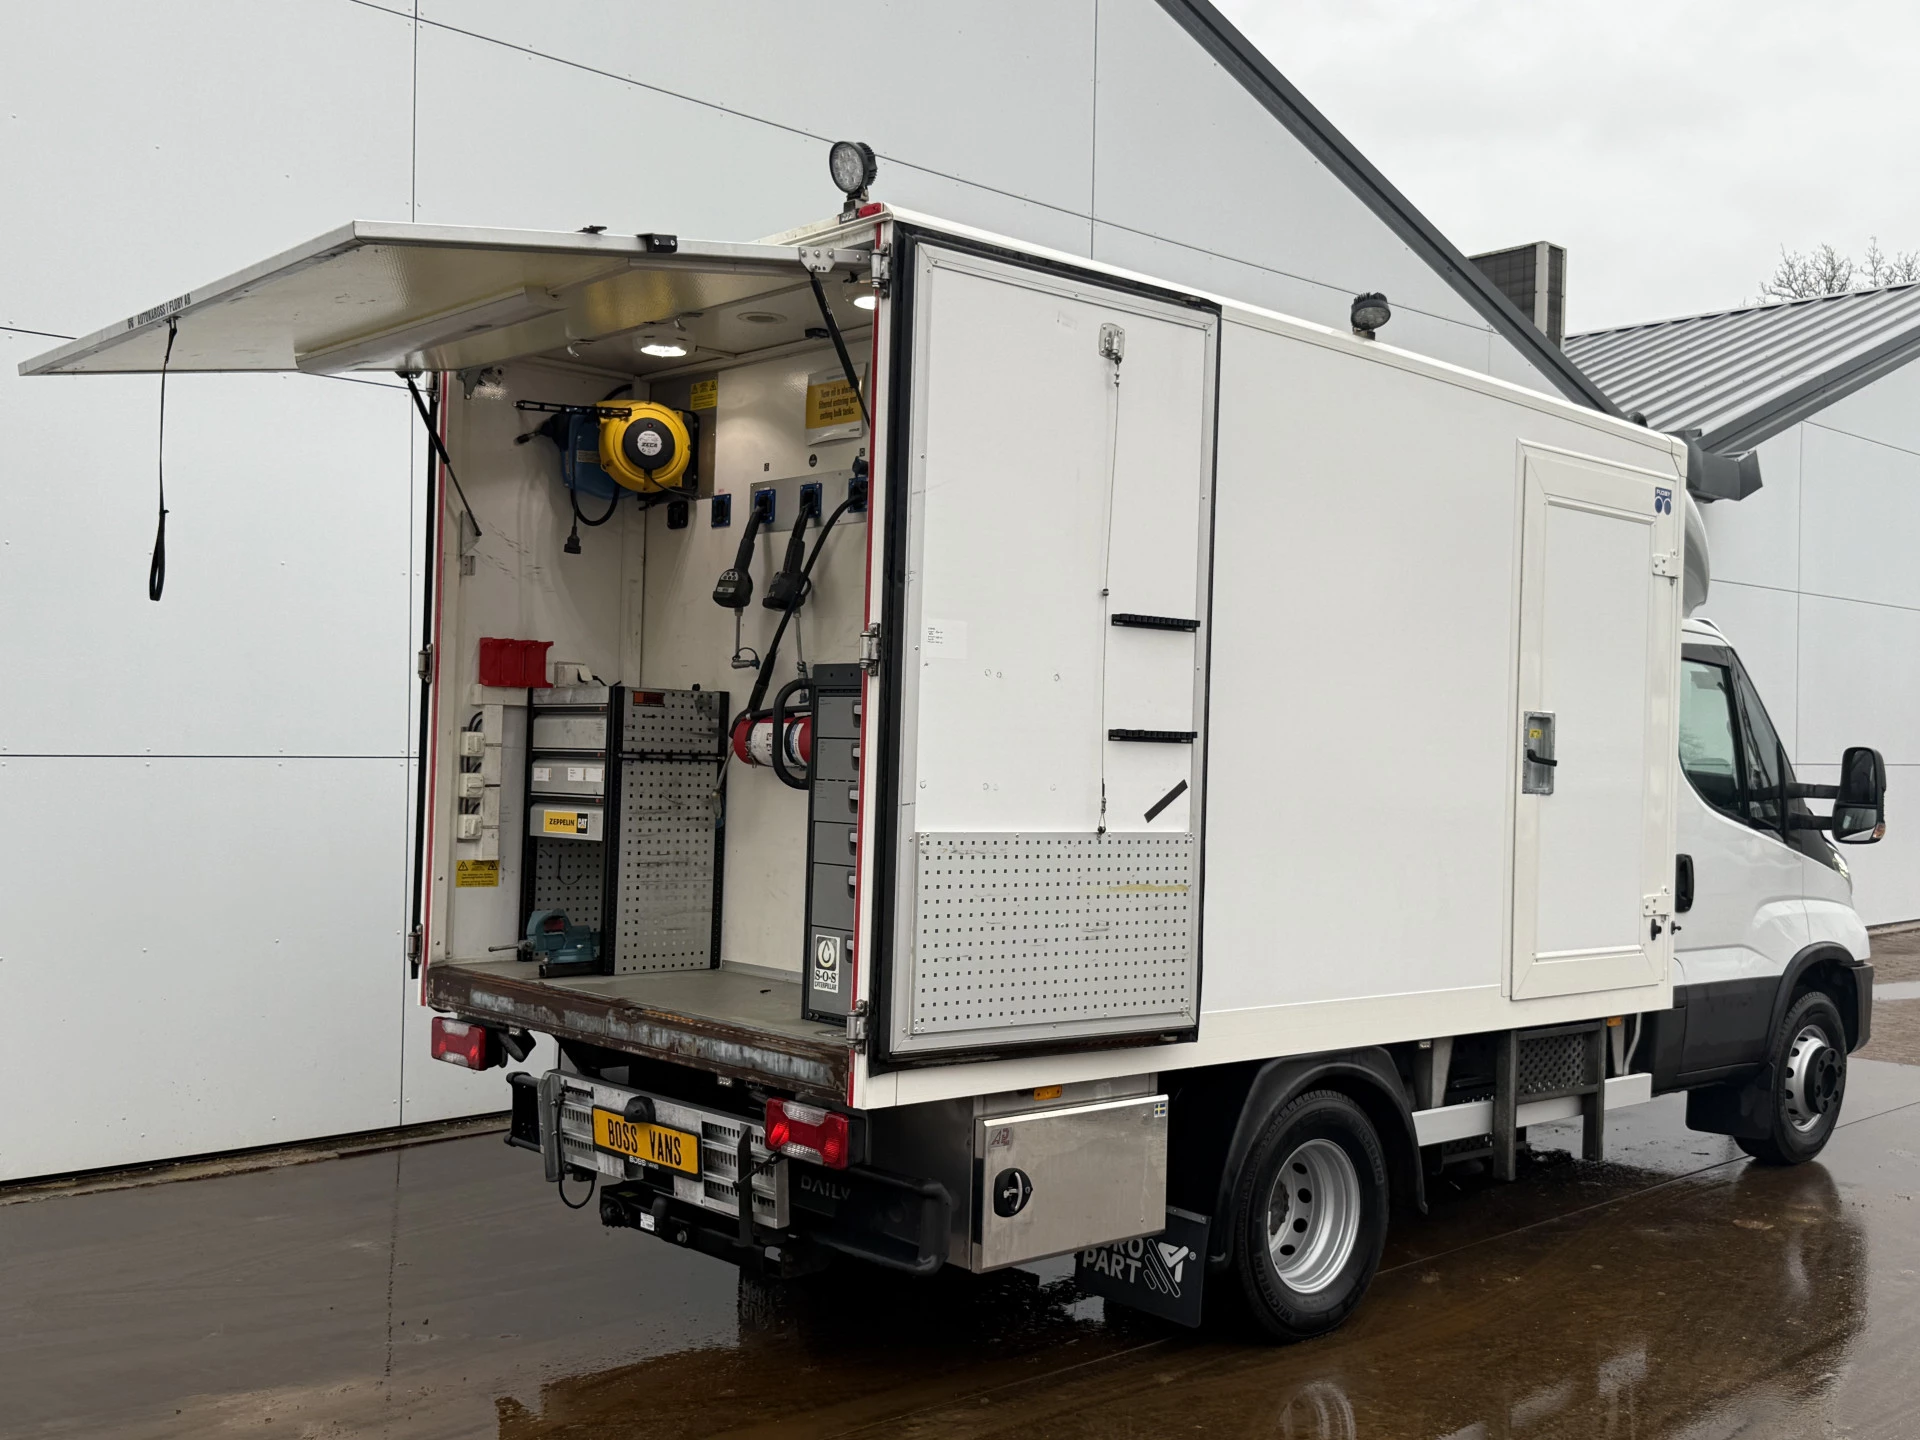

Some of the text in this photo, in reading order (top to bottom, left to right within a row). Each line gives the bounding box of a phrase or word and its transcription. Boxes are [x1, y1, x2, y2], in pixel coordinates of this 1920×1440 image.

[169, 296, 183, 312] FLOBY
[549, 817, 588, 829] ZEPPELIN CAT
[815, 981, 837, 990] CATERPILLAR
[607, 1118, 682, 1166] BOSS VANS
[629, 1155, 647, 1167] BOSS
[801, 1174, 851, 1200] DAILY
[1082, 1248, 1142, 1284] PART
[1254, 1252, 1295, 1322] MICHELIN
